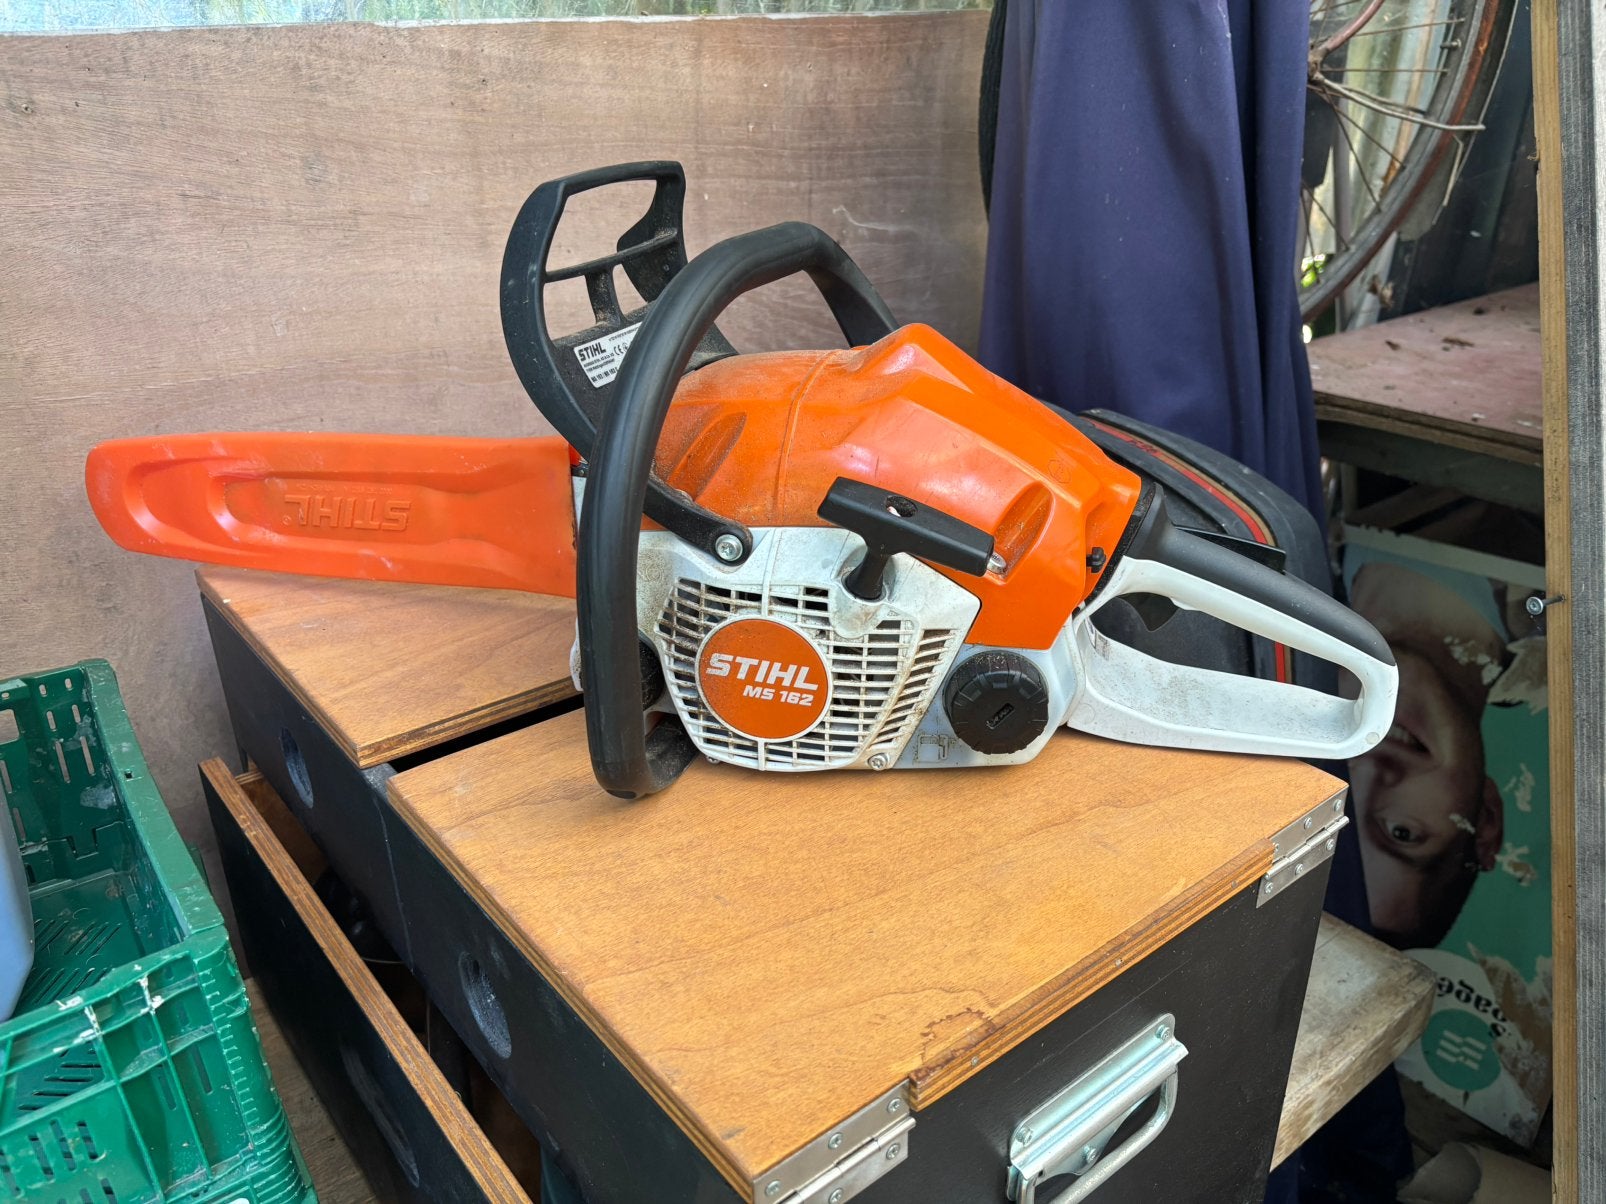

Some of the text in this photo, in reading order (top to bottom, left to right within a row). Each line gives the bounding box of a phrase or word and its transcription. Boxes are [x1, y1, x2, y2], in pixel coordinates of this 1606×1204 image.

[578, 342, 606, 362] STIHL
[284, 494, 412, 532] STIHL
[706, 652, 819, 691] STIHL
[743, 685, 814, 707] MS 162
